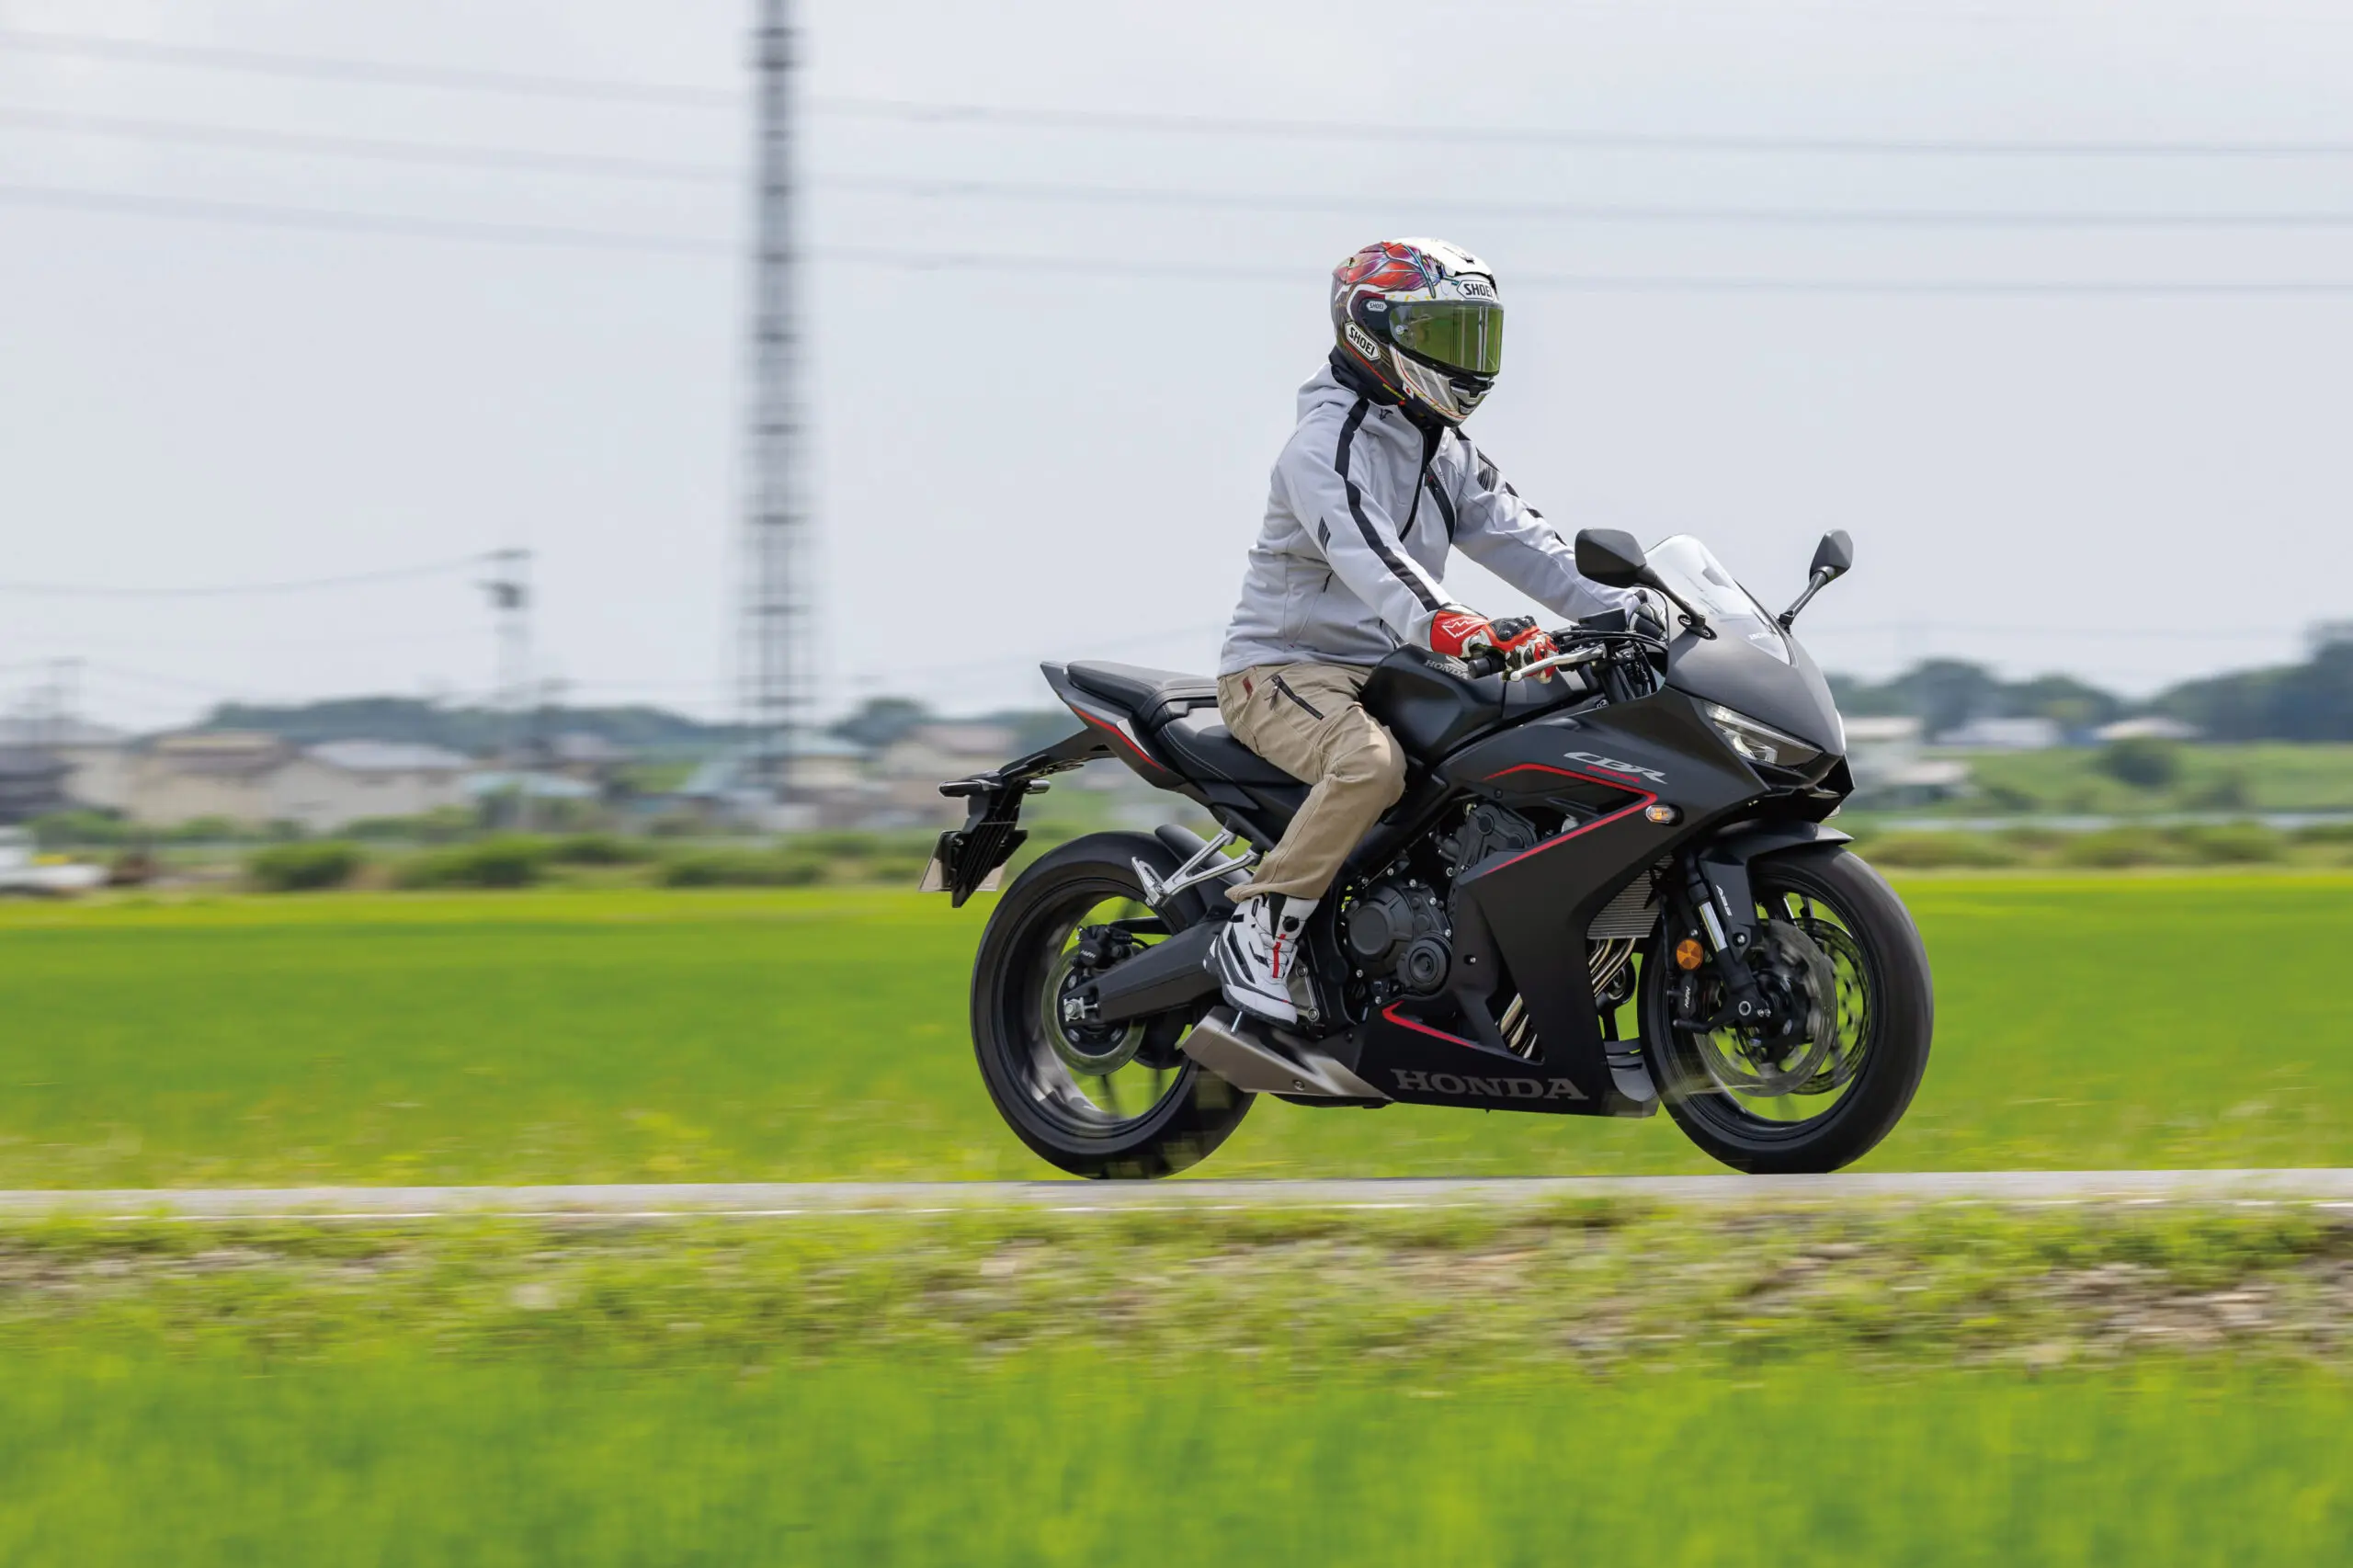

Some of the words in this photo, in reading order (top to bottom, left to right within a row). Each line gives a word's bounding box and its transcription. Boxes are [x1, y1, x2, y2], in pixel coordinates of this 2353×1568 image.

[1463, 283, 1494, 299] SHOEI
[1348, 326, 1376, 357] SHOEI
[1425, 659, 1470, 680] HONDA
[1563, 752, 1668, 785] CBR
[1390, 1068, 1589, 1100] HONDA
